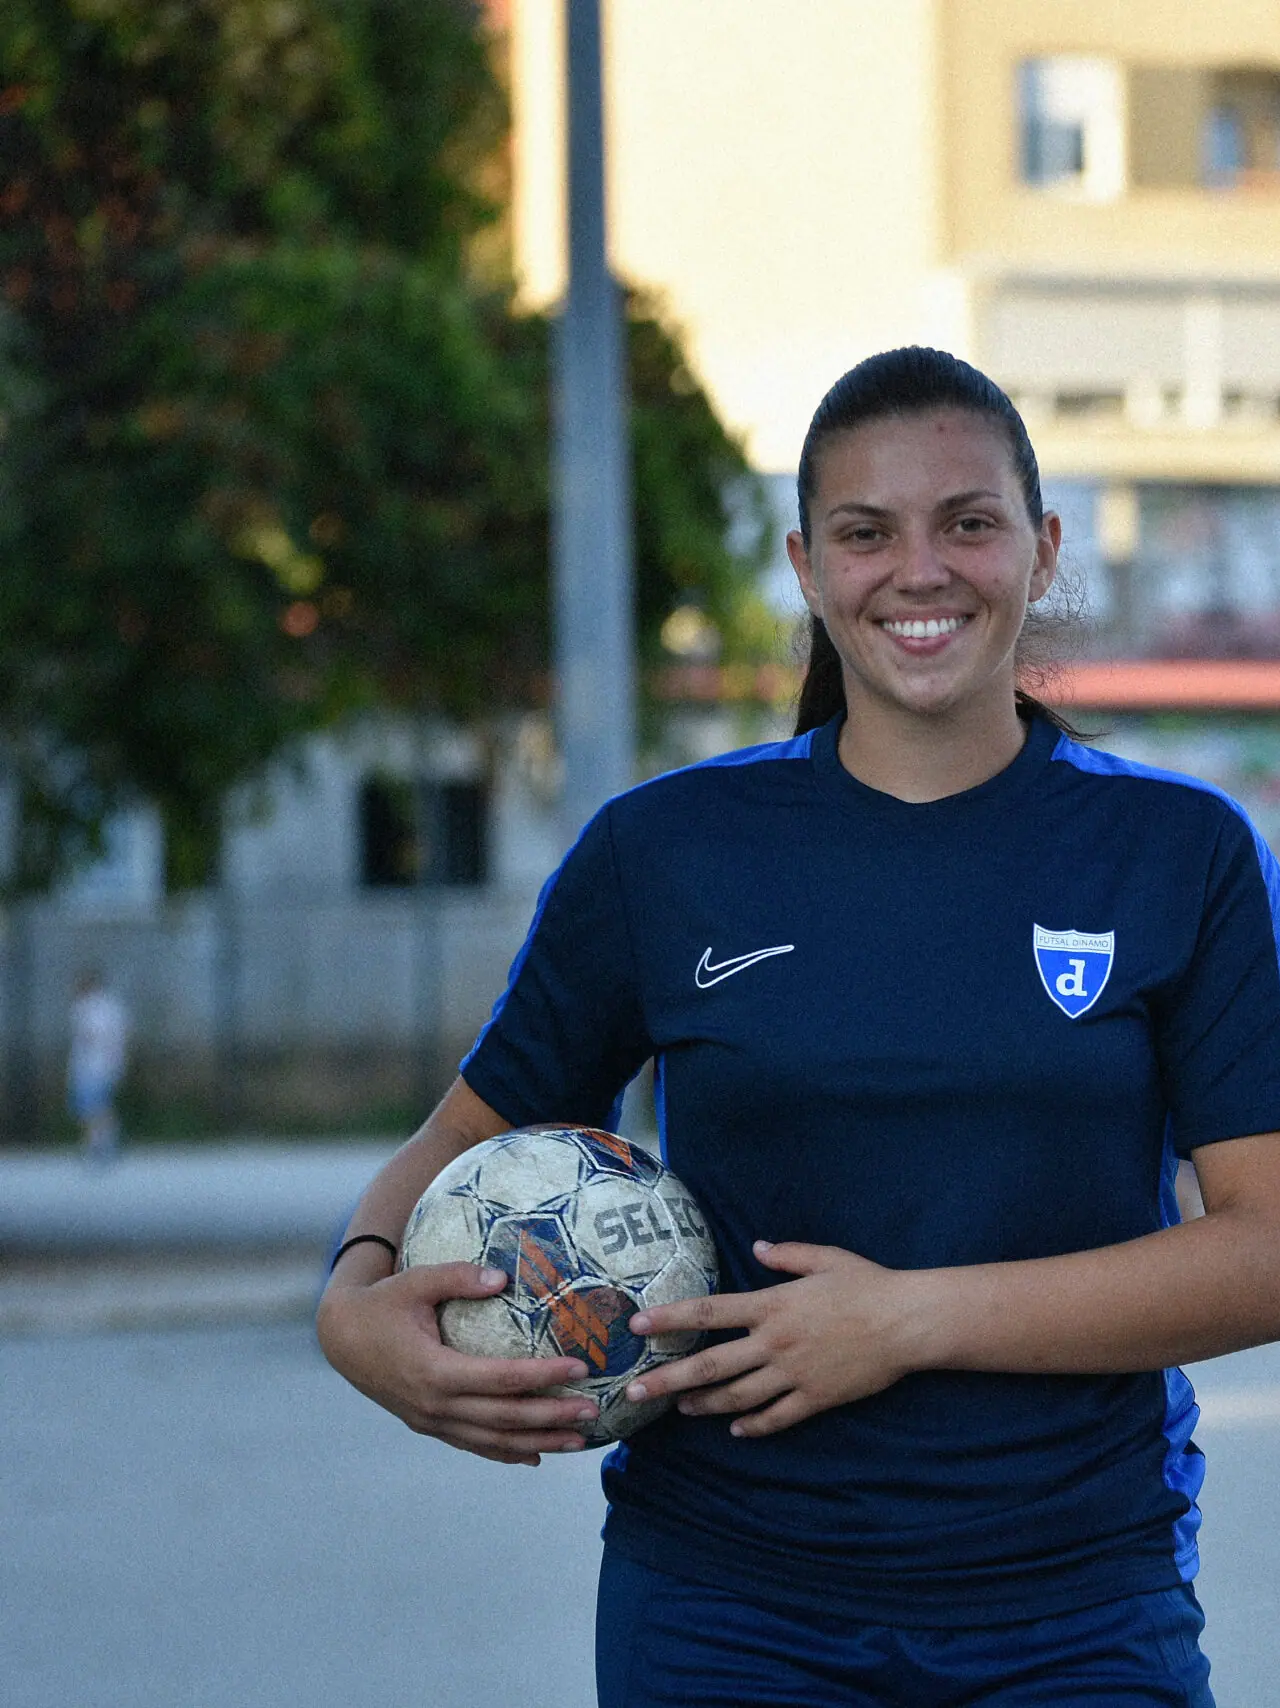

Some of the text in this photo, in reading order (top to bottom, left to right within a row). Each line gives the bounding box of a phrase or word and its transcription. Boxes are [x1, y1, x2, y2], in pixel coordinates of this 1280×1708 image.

[1039, 935, 1109, 948] FUTSAL DINAMO
[1056, 959, 1088, 996] d
